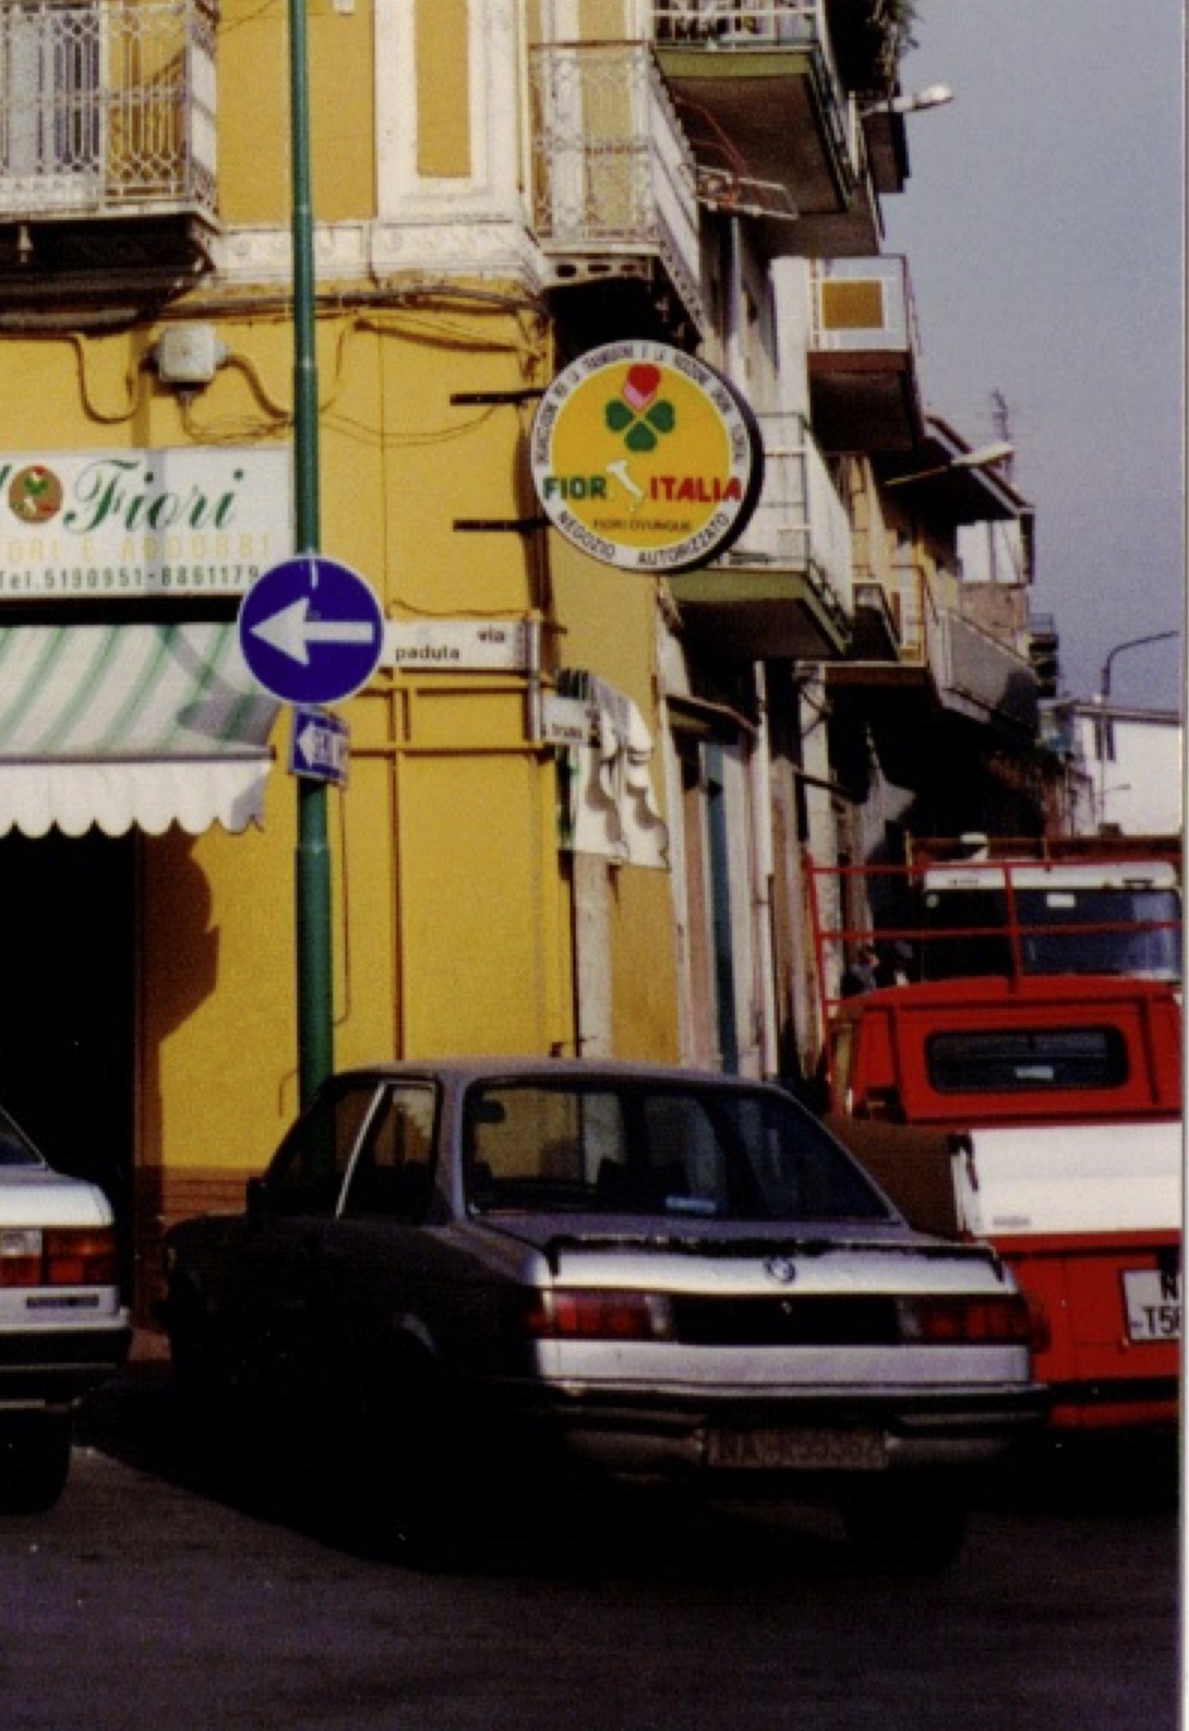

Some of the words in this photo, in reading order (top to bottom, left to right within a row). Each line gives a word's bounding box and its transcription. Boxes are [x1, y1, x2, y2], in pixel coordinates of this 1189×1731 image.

[62, 459, 245, 534] Fiori
[543, 477, 607, 501] FIOR
[650, 476, 742, 503] ITALIA
[81, 534, 94, 561] E
[558, 510, 615, 558] NEGOZIO
[638, 513, 730, 565] AUTORIZZATO
[477, 625, 505, 643] via
[395, 644, 460, 662] padula
